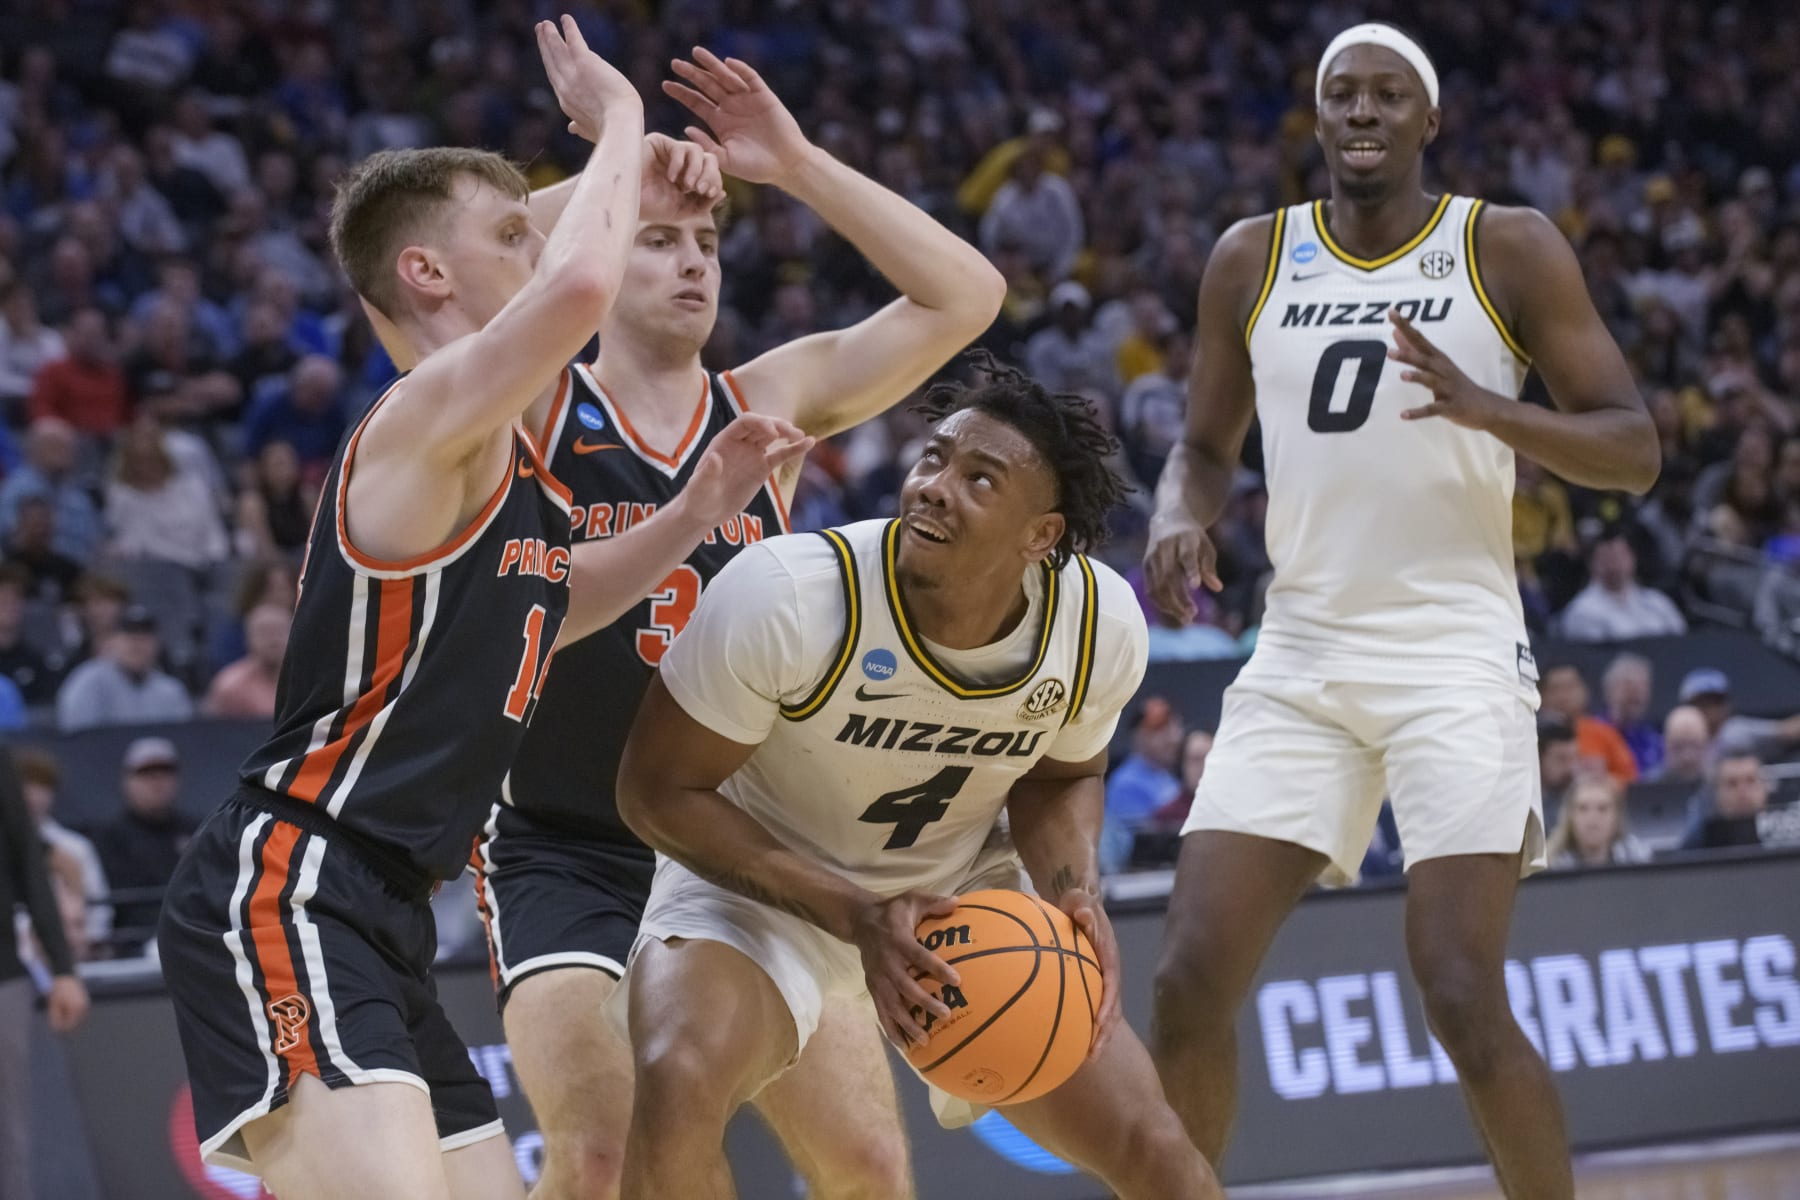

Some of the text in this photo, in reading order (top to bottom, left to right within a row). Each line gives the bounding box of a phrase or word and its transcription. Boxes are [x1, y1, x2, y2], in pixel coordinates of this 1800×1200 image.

[1421, 251, 1455, 279] SEC
[1280, 298, 1453, 328] MIZZOU
[1307, 339, 1387, 433] 0
[497, 538, 572, 587] PRINC
[635, 563, 702, 668] 3
[503, 603, 565, 728] 1
[865, 661, 894, 676] NCAA
[1027, 679, 1064, 712] SEC
[835, 713, 1049, 757] MIZZOU
[857, 765, 974, 850] 4
[268, 993, 310, 1054] P
